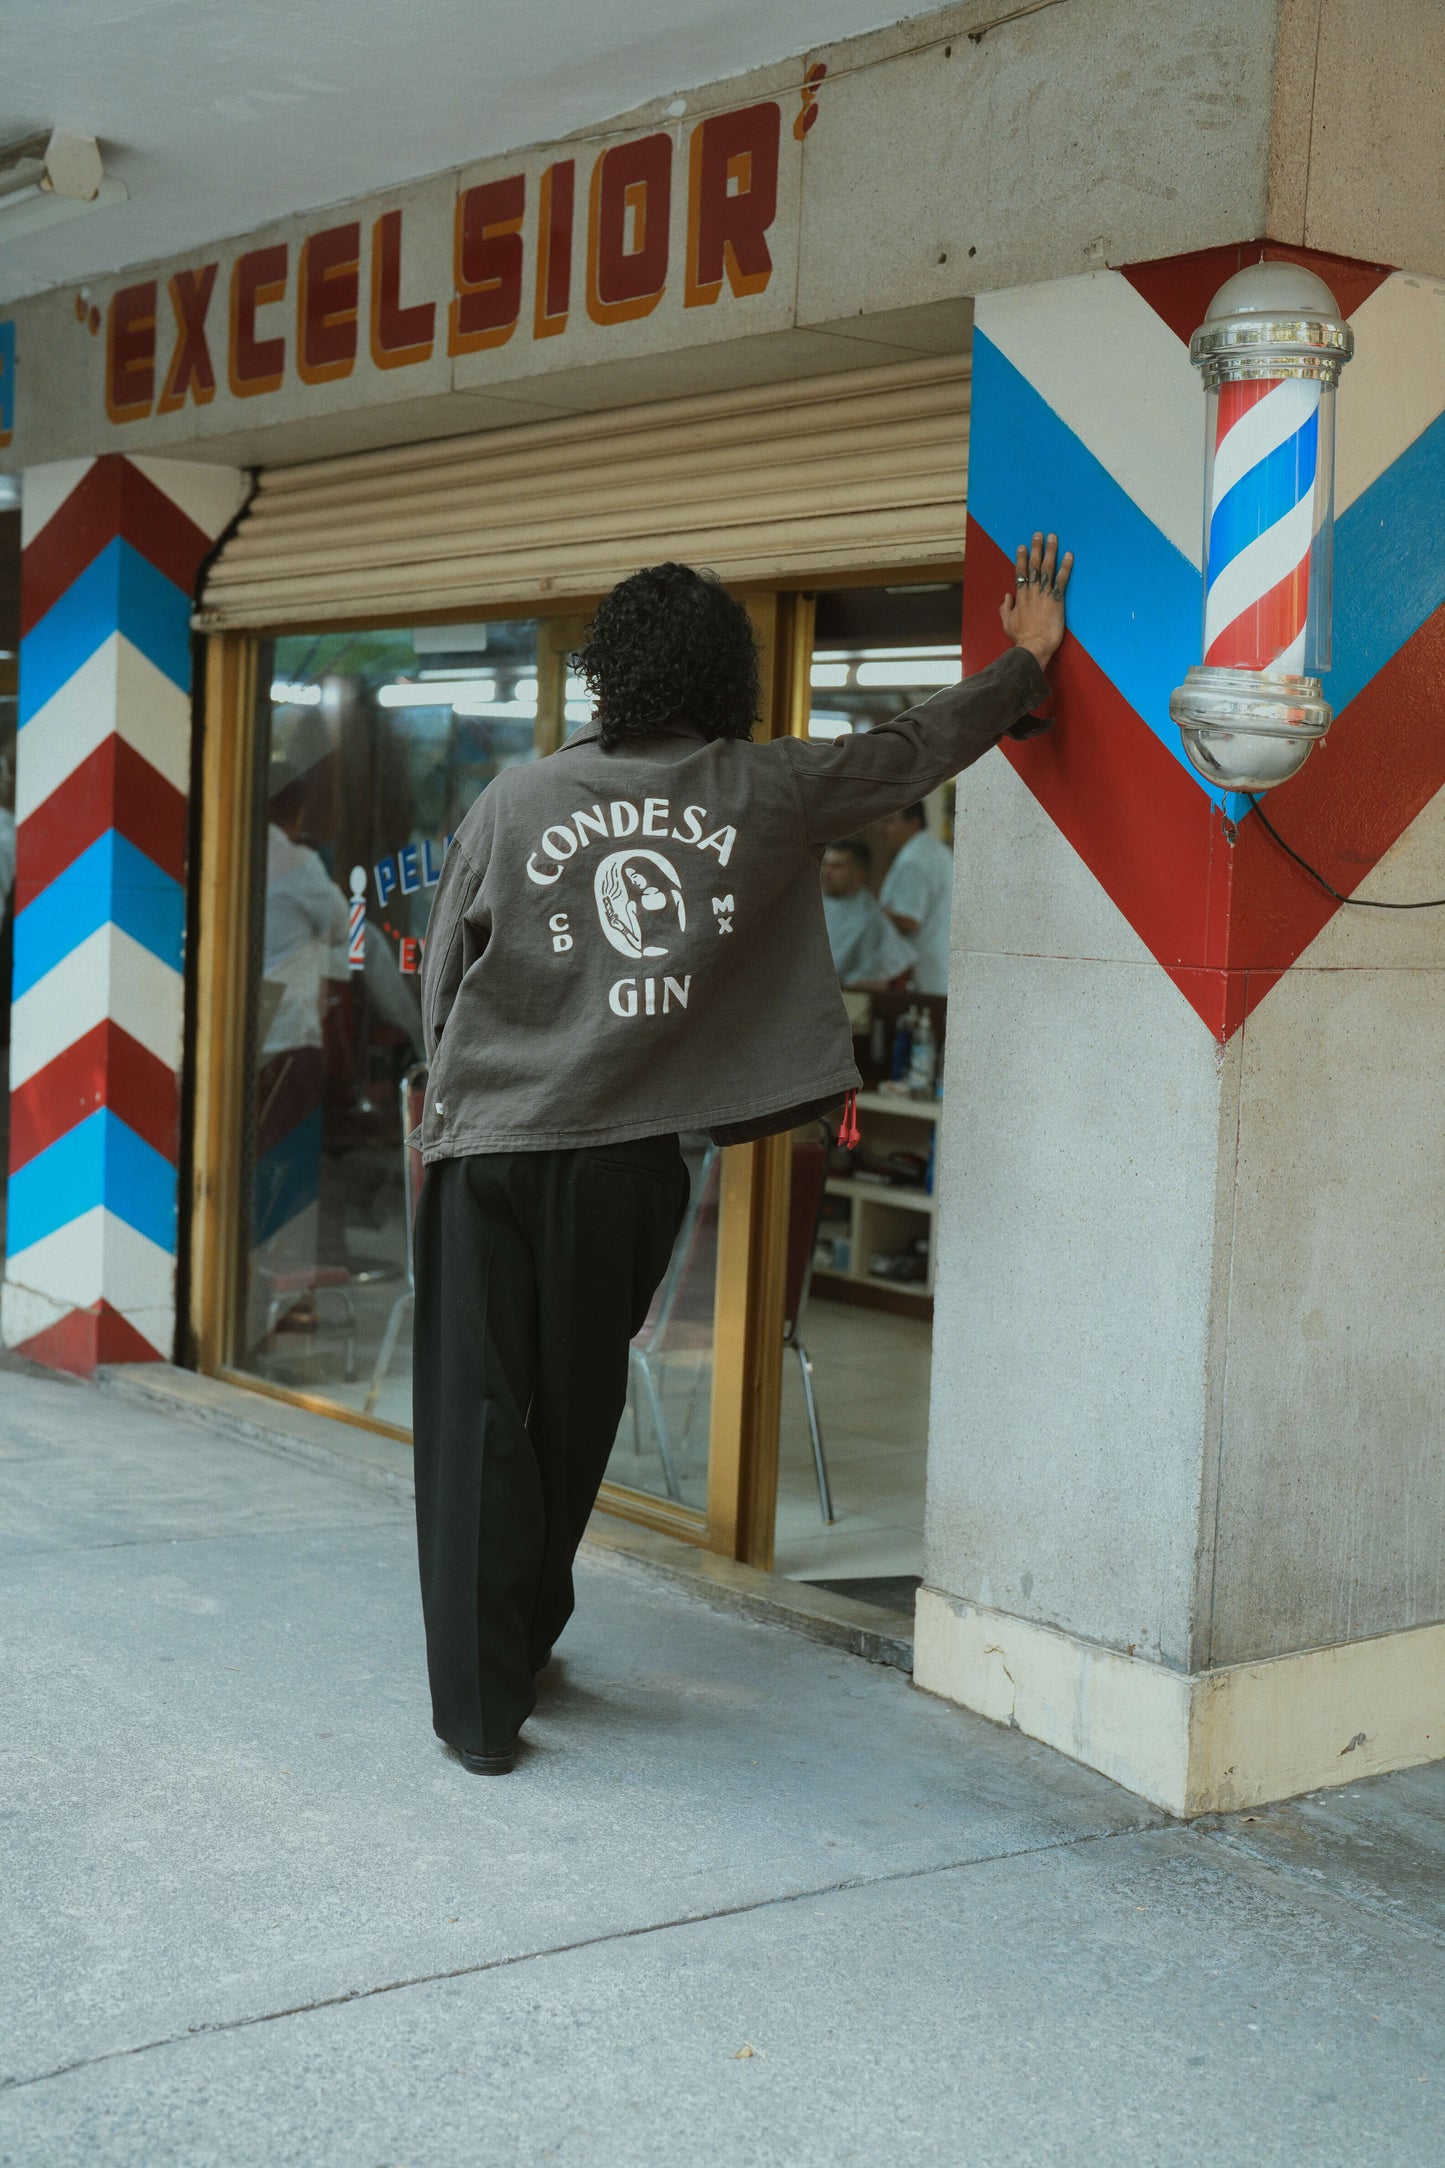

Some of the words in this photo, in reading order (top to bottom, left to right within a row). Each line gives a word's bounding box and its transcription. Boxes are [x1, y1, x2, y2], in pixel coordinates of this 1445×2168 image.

[374, 834, 454, 908] PEL
[526, 798, 737, 885] CONDESA
[609, 975, 692, 1017] GIN
